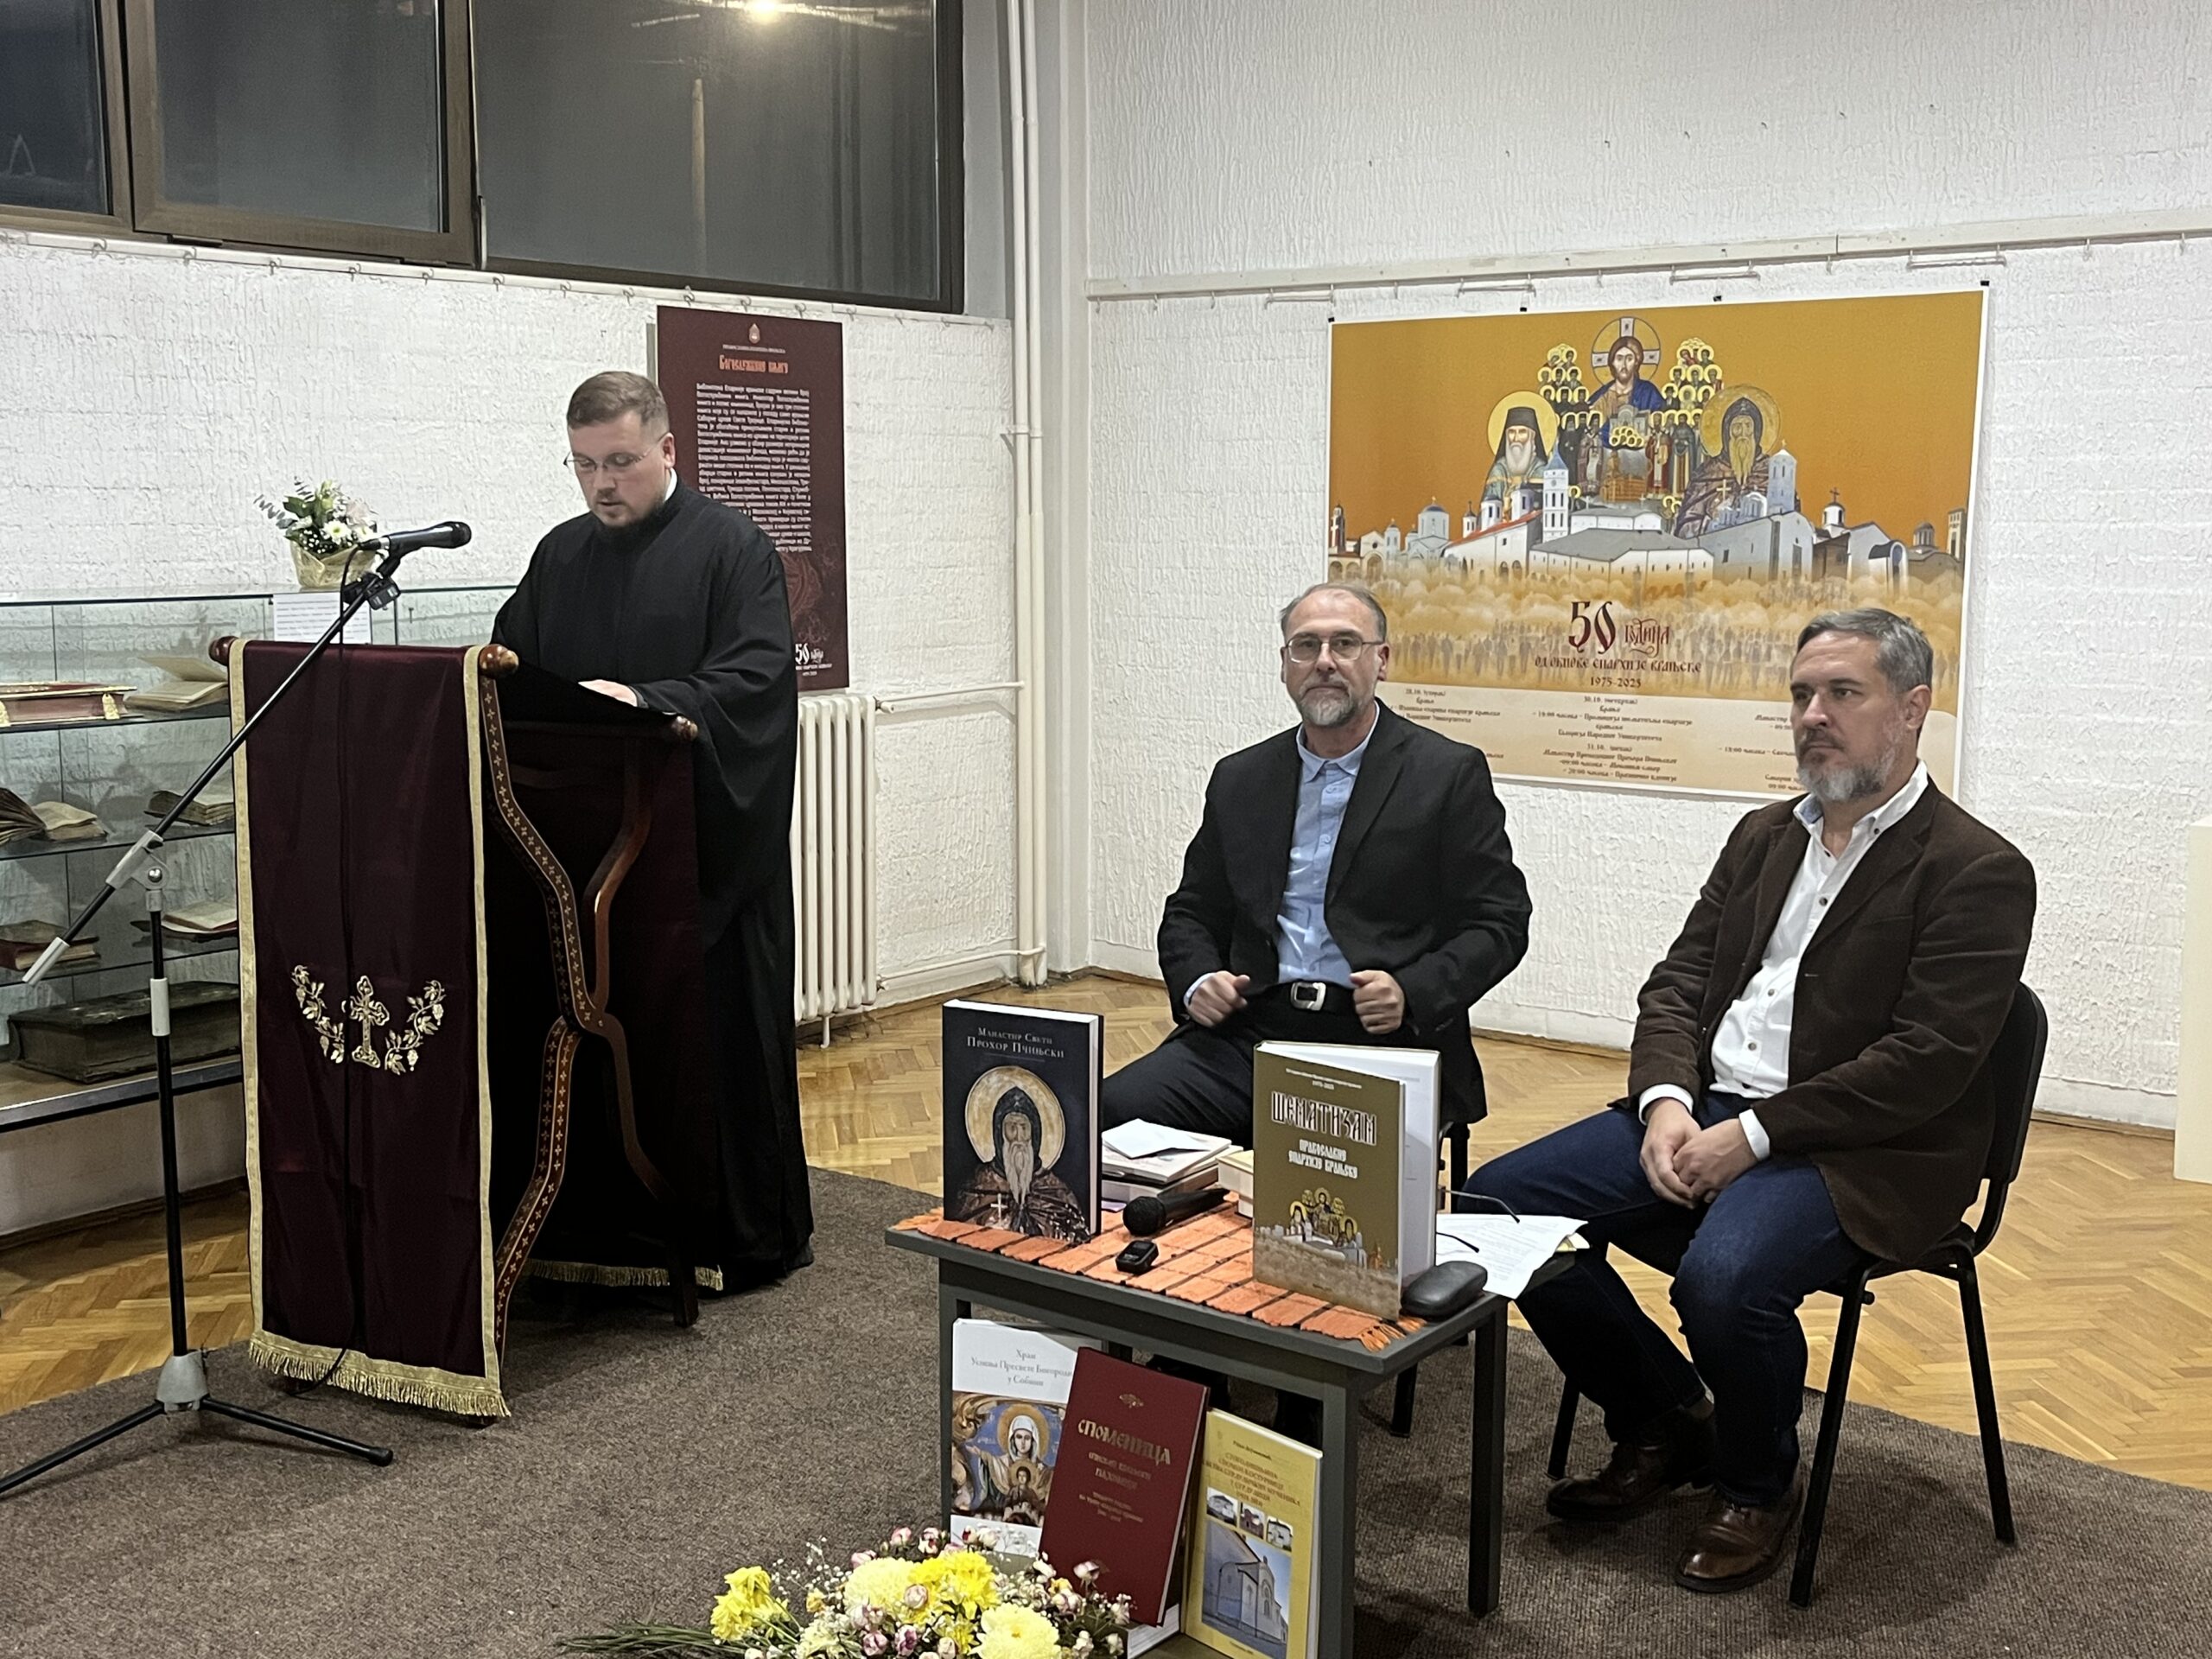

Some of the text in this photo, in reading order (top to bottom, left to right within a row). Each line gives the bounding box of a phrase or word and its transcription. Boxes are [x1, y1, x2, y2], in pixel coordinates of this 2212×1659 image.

[1568, 601, 1616, 654] 50
[795, 643, 810, 664] 50
[1591, 677, 1641, 688] 1975-2025
[1271, 1091, 1376, 1146] ШЕМАТИЗАМ
